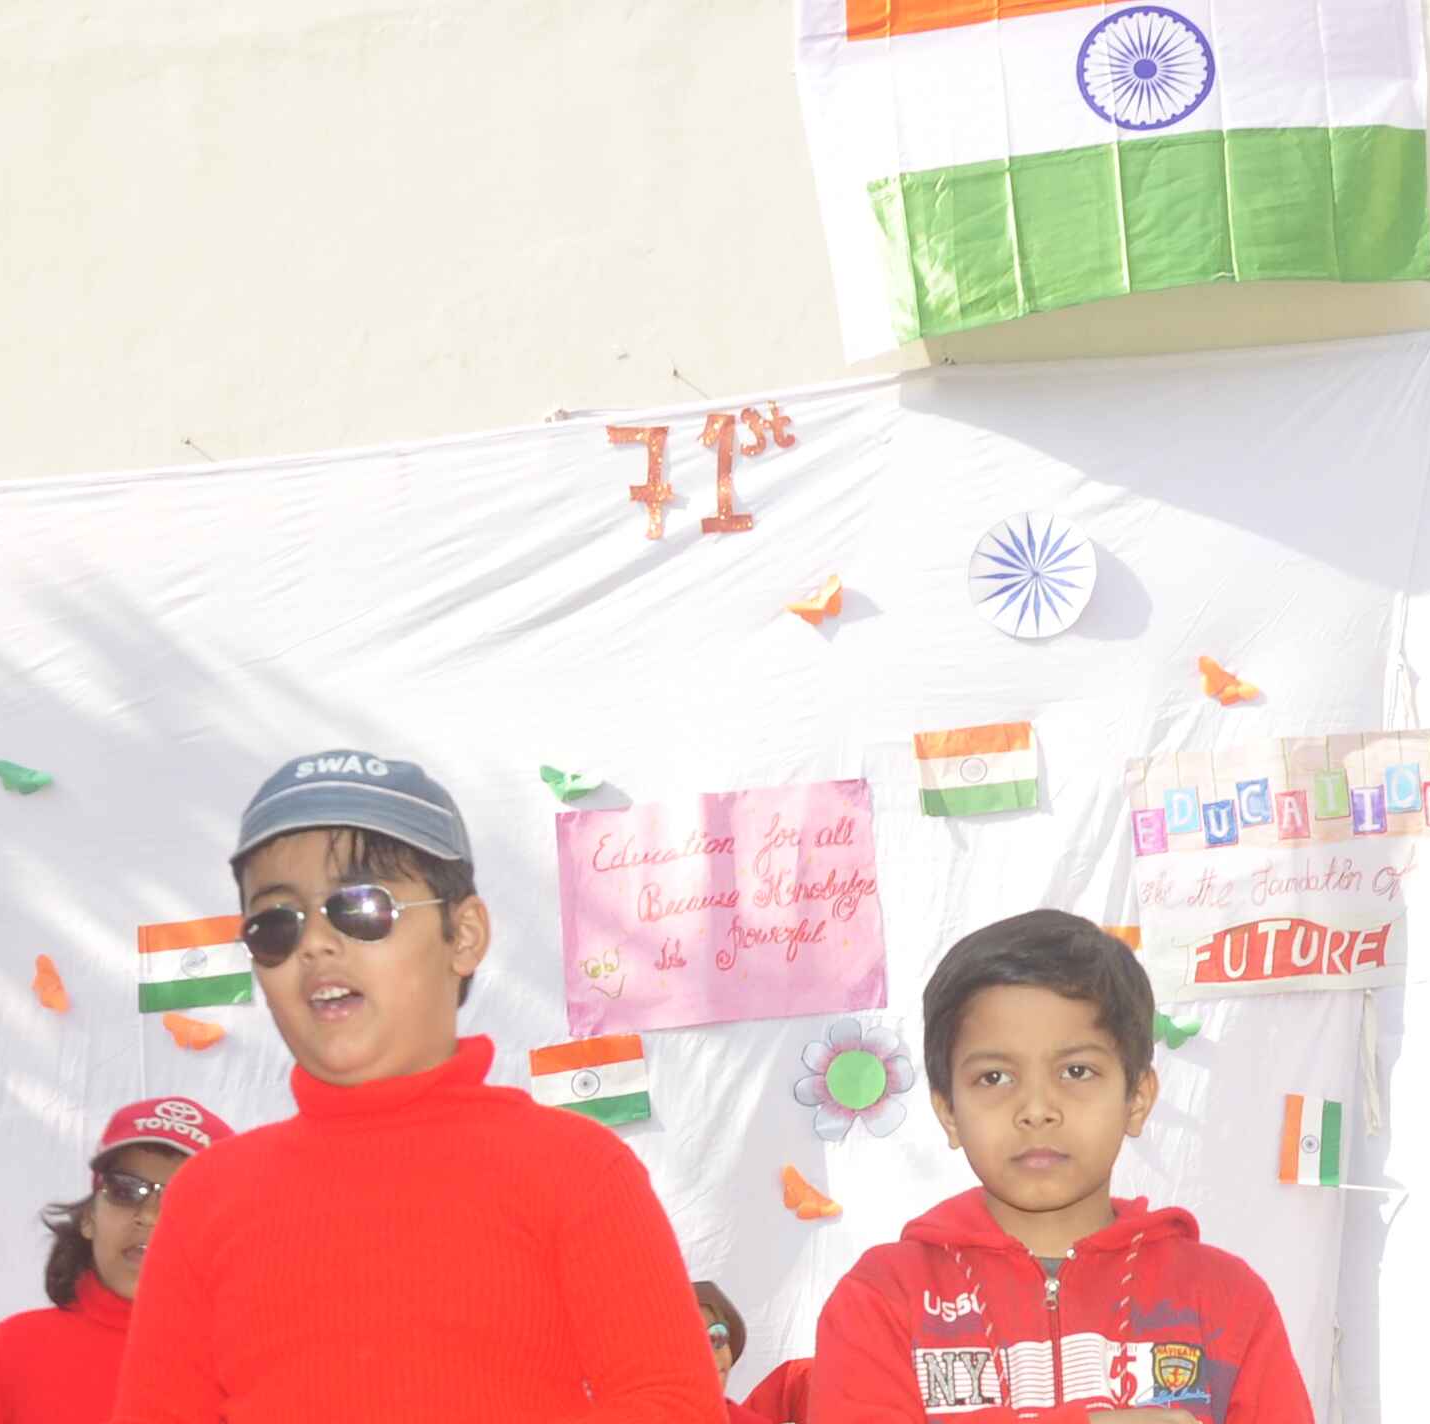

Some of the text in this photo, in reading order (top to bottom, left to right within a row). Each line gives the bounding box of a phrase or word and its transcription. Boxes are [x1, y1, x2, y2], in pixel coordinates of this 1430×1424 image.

[295, 755, 390, 779] SWAG
[593, 829, 736, 873] Education
[754, 813, 803, 877] for
[637, 882, 740, 923] Because
[1174, 917, 1392, 987] FUTURE
[134, 1117, 212, 1149] TOYOTA
[922, 1350, 996, 1408] NY
